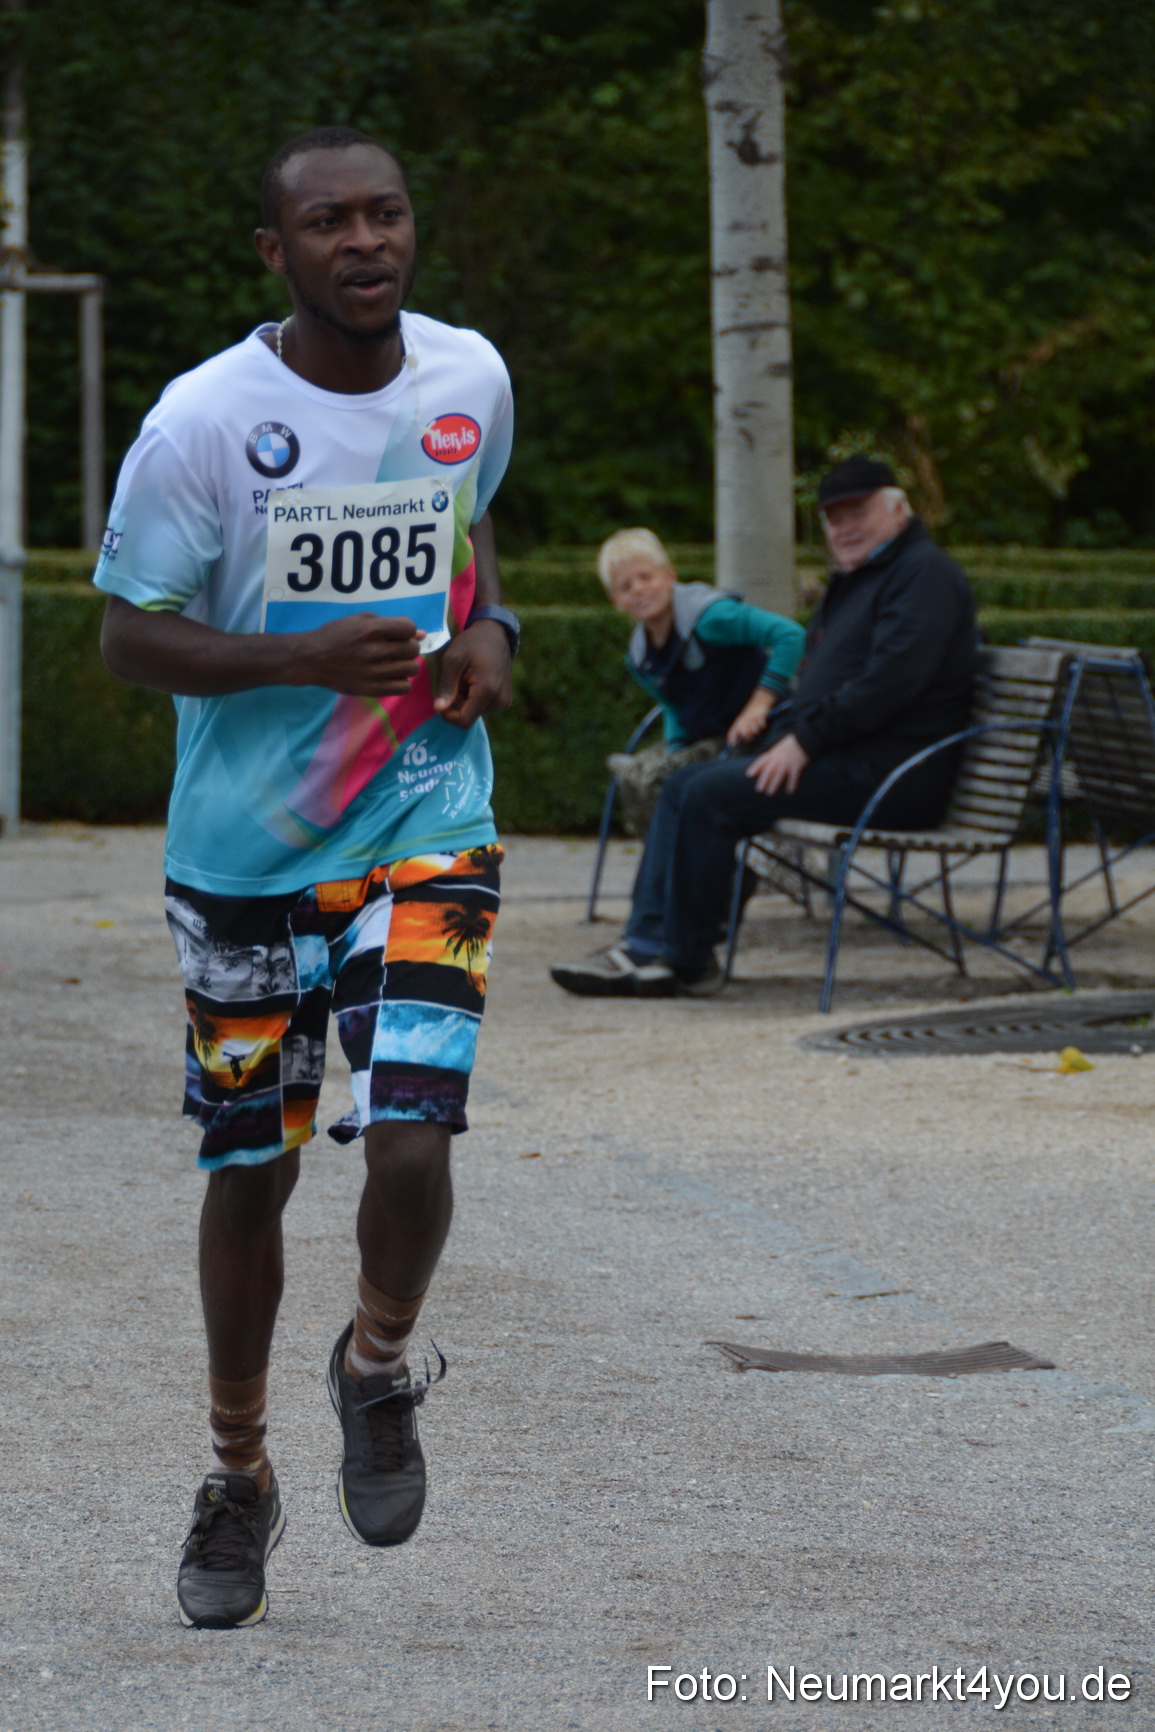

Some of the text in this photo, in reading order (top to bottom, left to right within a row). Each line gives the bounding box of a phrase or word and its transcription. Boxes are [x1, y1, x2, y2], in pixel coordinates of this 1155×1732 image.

[249, 423, 293, 444] BMW
[273, 505, 338, 523] PARTL
[343, 498, 425, 520] Neumarkt
[287, 522, 437, 594] 3085
